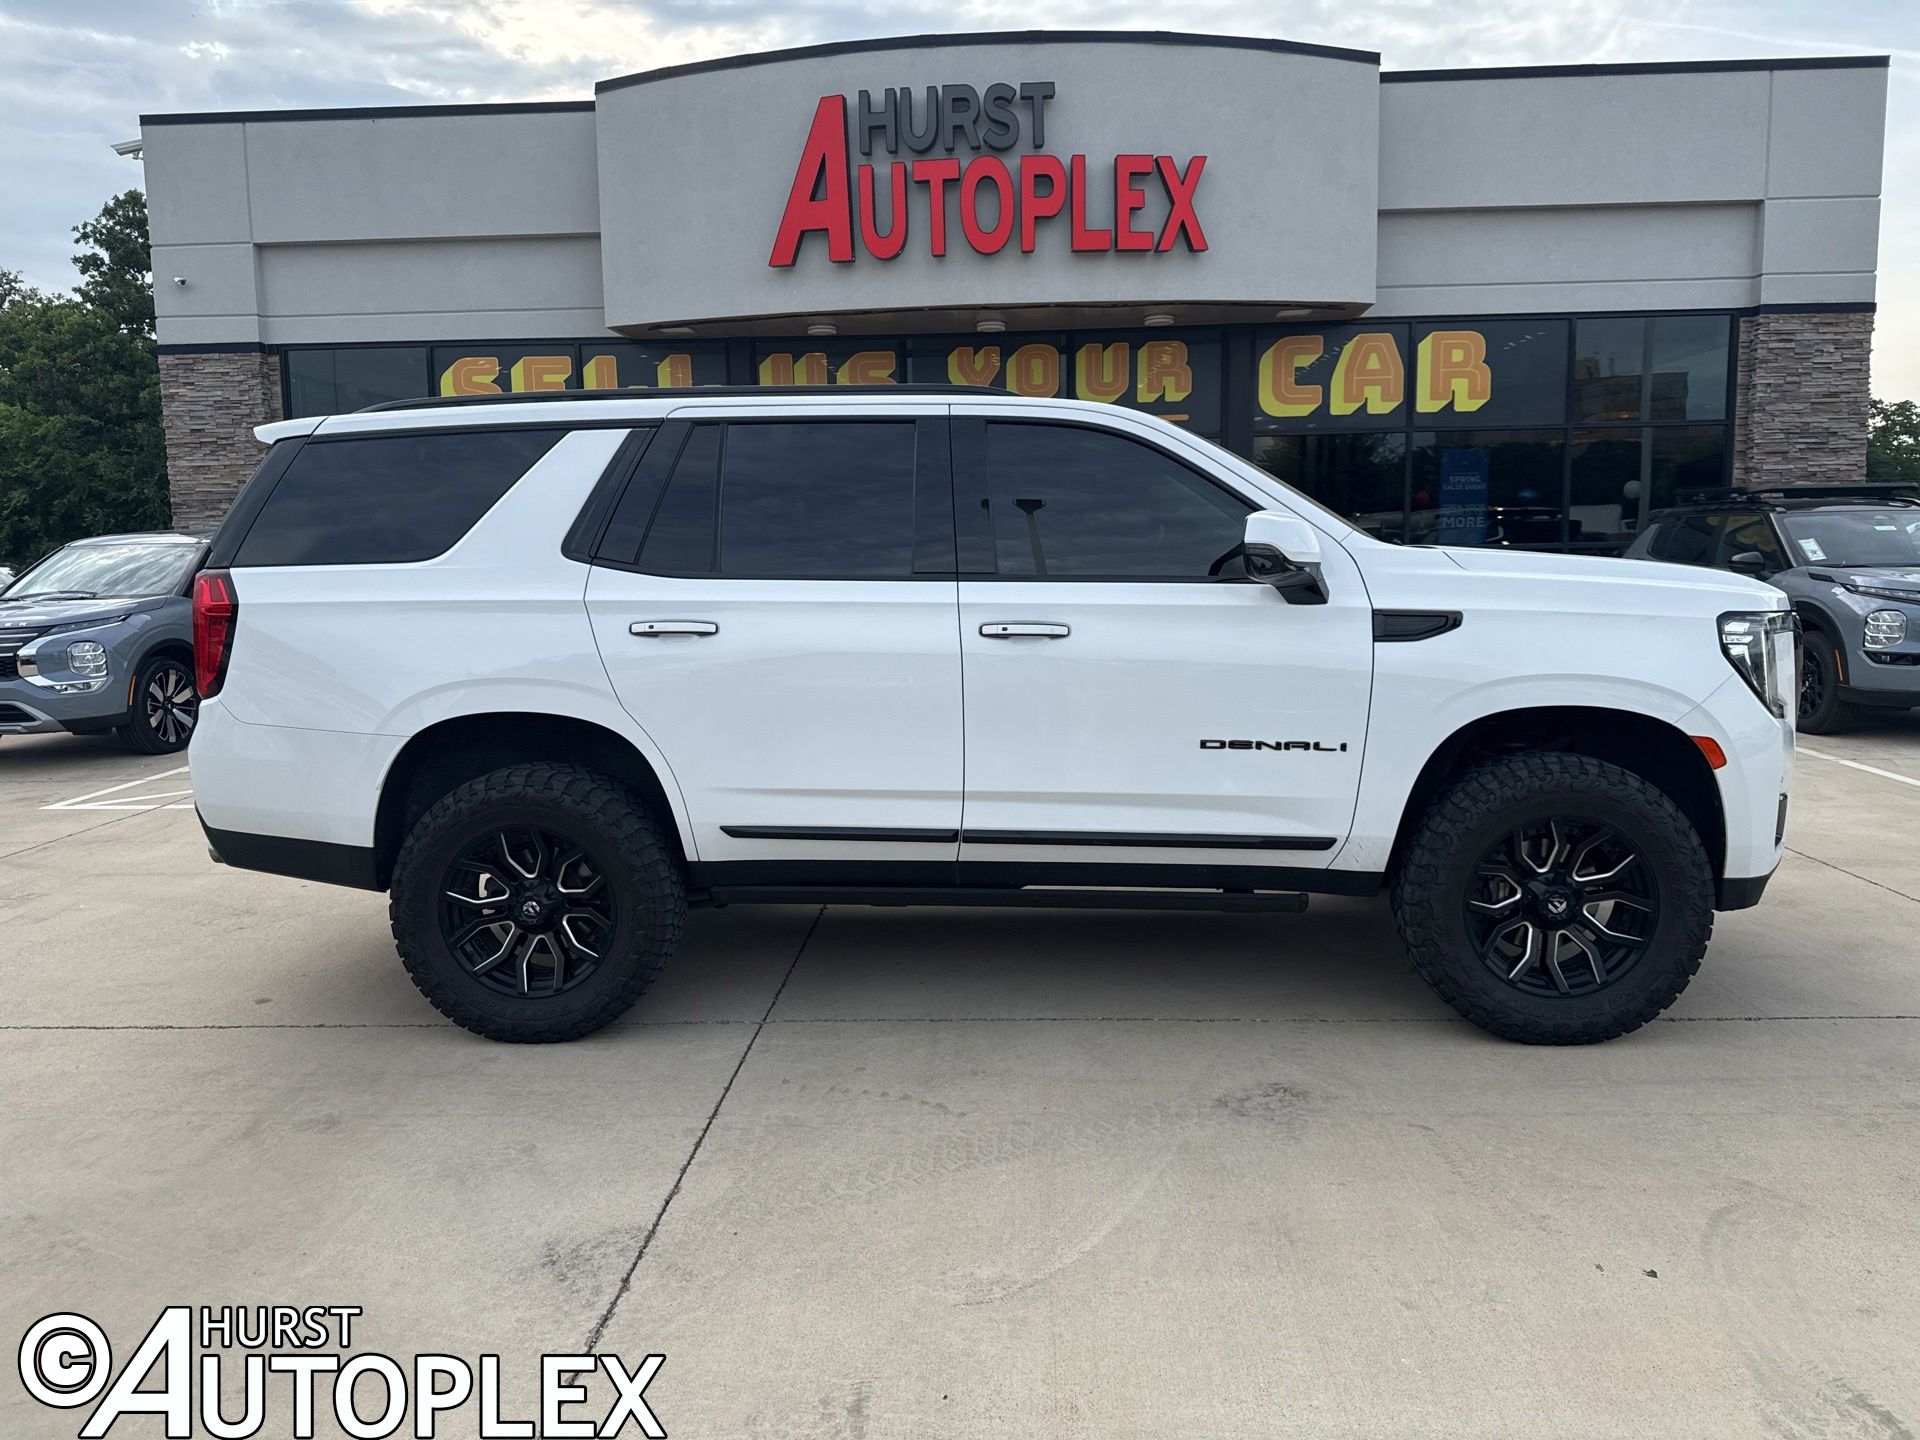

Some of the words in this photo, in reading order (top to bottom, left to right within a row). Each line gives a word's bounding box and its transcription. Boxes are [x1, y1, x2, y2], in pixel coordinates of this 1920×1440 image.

[857, 81, 1056, 156] HURST
[768, 94, 1209, 268] AUTOPLEX
[947, 340, 1193, 403] YOUR
[1258, 330, 1492, 417] CAR
[1442, 516, 1486, 528] MORE
[1199, 739, 1348, 752] DENALI
